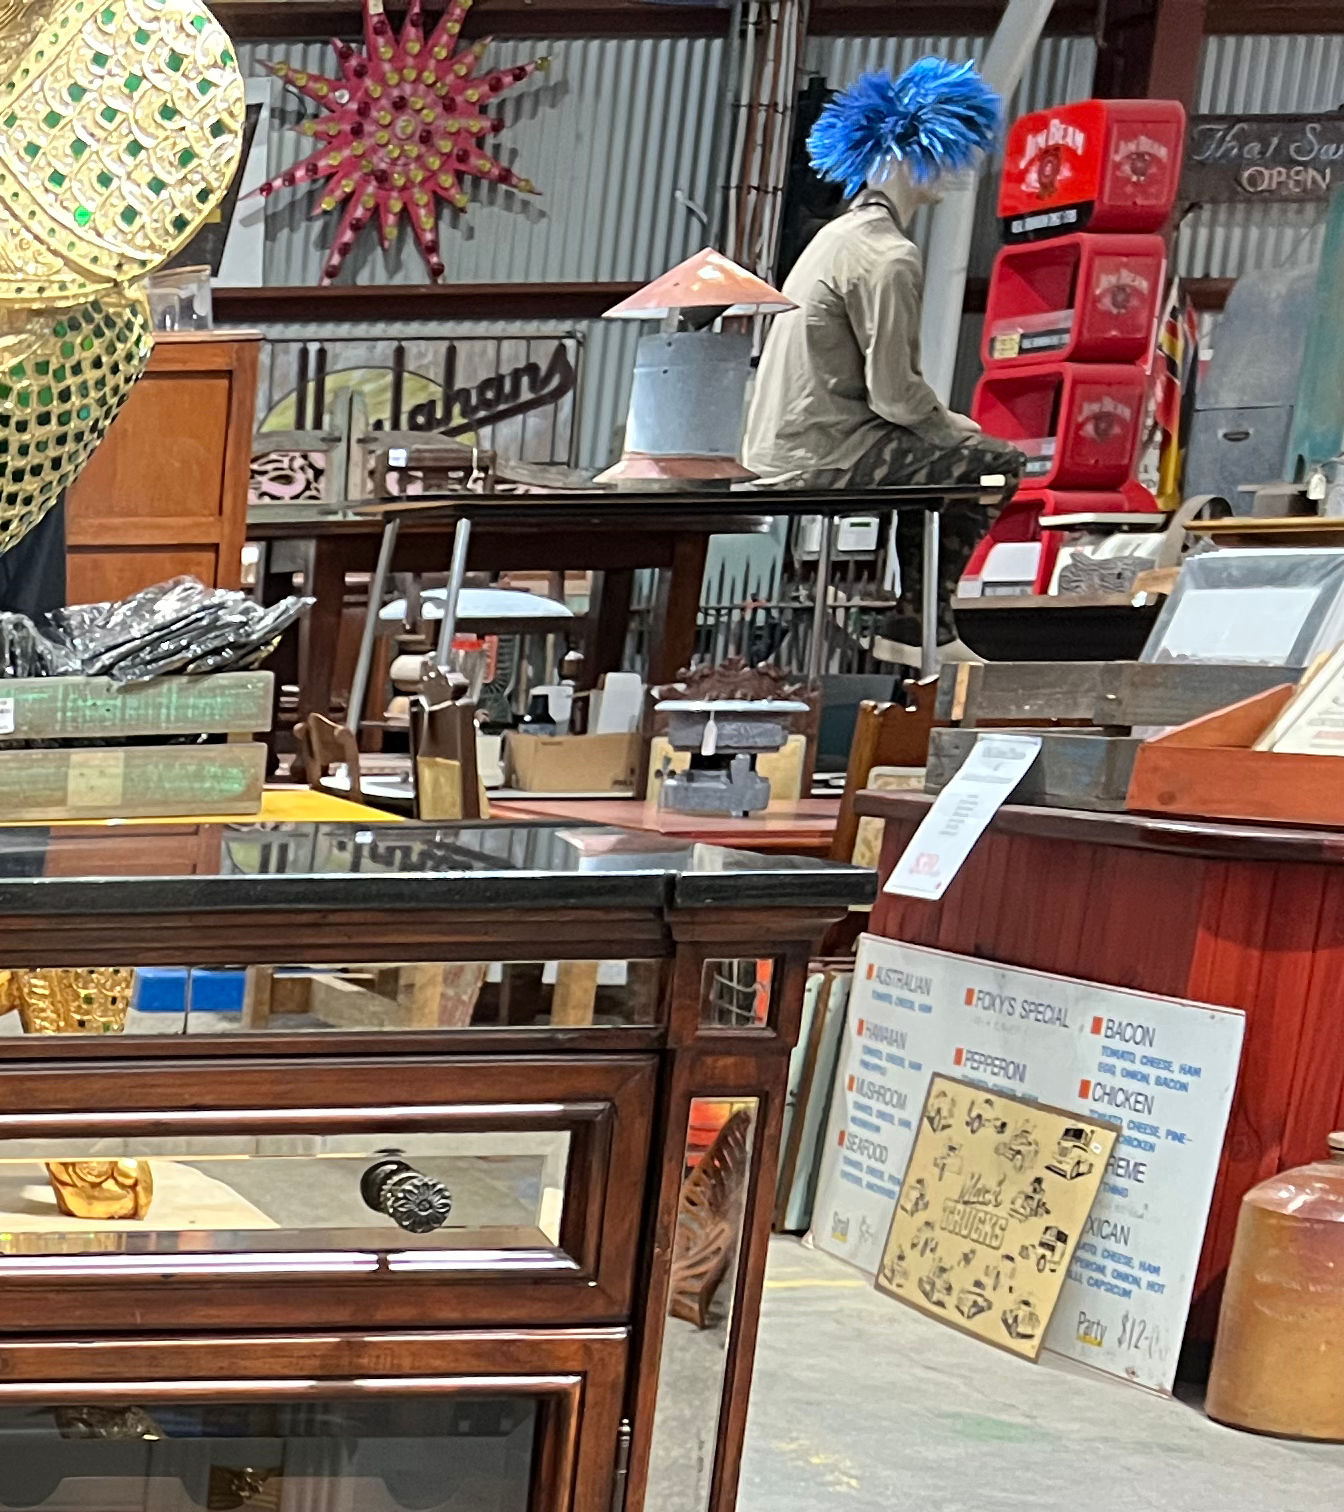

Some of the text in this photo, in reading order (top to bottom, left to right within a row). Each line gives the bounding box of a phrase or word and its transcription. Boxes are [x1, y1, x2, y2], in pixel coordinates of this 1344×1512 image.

[1048, 118, 1085, 156] BEAM
[1242, 166, 1331, 193] OPEN
[974, 990, 1017, 1017] FOXY'S
[1020, 1000, 1070, 1028] SPECIAL
[1104, 1018, 1156, 1047] BACON
[964, 1050, 1028, 1083] PEPPERONI
[855, 1078, 908, 1110] MUSHROOM
[1092, 1082, 1155, 1115] CHICKEN
[845, 1133, 889, 1164] SEAFOOD
[1106, 1156, 1148, 1183] REME
[940, 1197, 1009, 1250] TRUCKS
[1086, 1217, 1132, 1246] XICAN
[1076, 1311, 1108, 1341] Party
